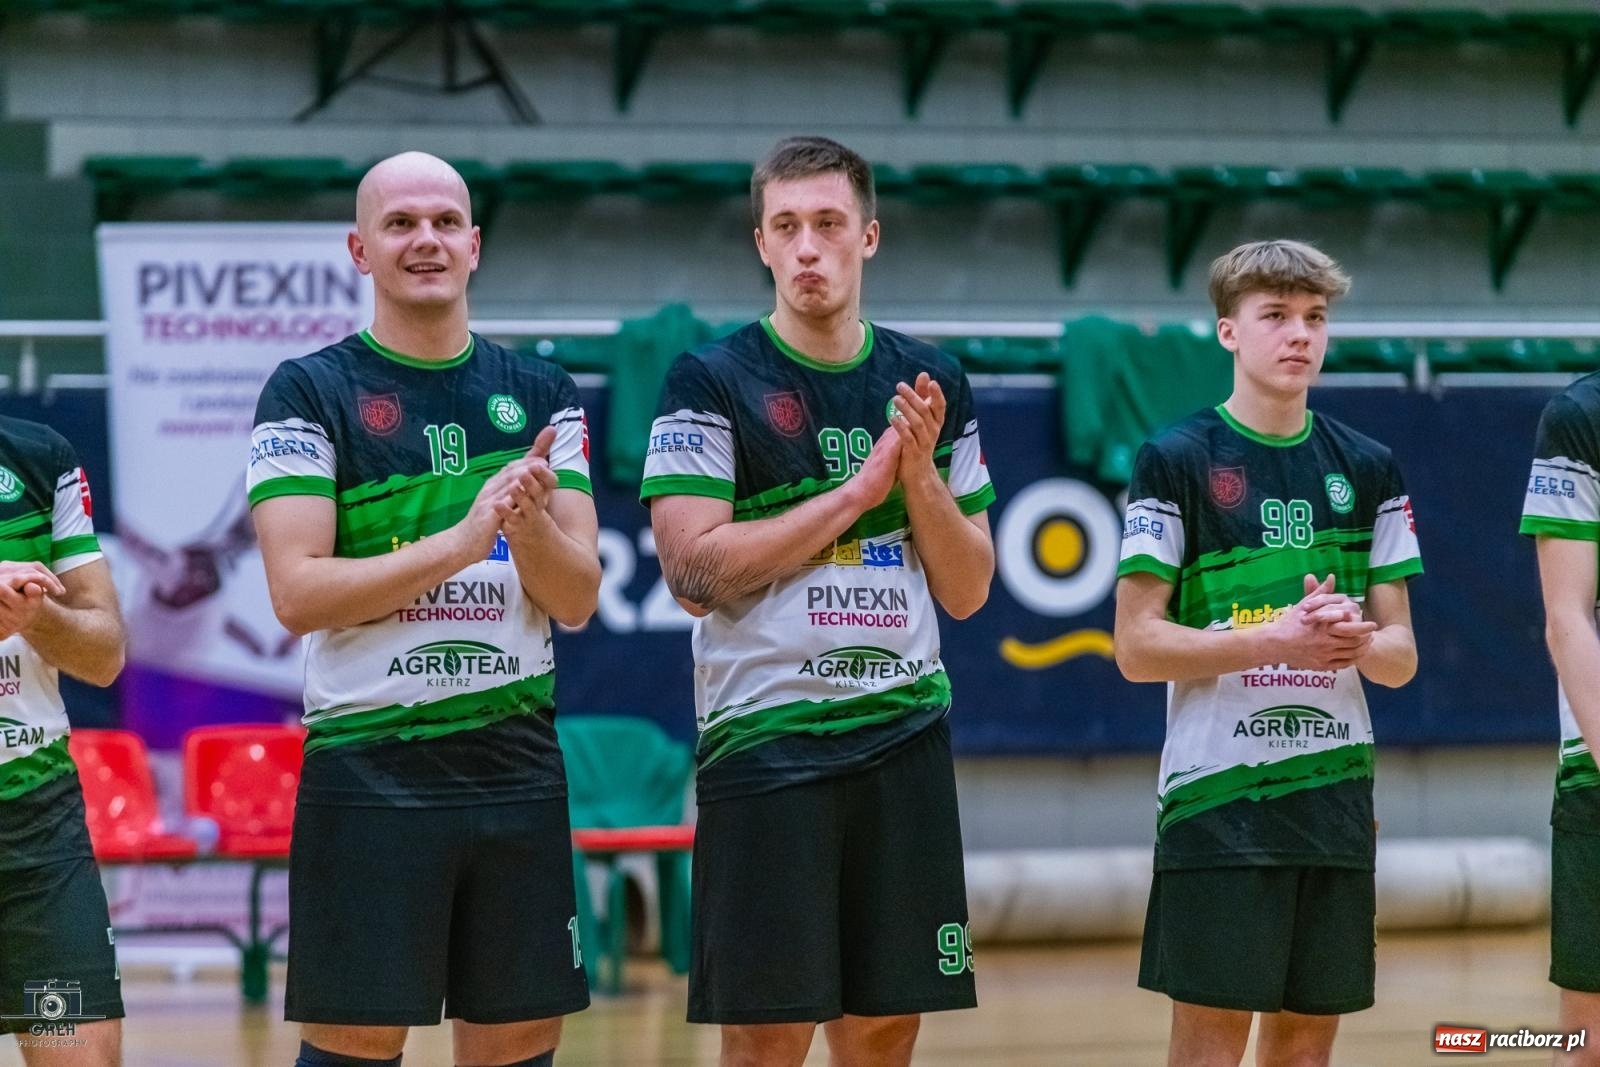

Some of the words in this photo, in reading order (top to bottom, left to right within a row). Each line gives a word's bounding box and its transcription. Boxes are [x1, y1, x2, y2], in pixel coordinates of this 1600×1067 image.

[138, 261, 359, 305] PIVEXIN
[143, 315, 356, 341] TECHNOLOGY
[423, 422, 468, 476] 19
[1261, 498, 1314, 549] 98
[807, 585, 908, 611] PIVEXIN
[398, 607, 505, 622] TECHNOLOGY
[808, 612, 908, 628] TECHNOLOGY
[426, 678, 471, 687] KIETRZ
[1241, 674, 1337, 690] TECHNOLOGY
[1268, 740, 1309, 749] KIETRZ
